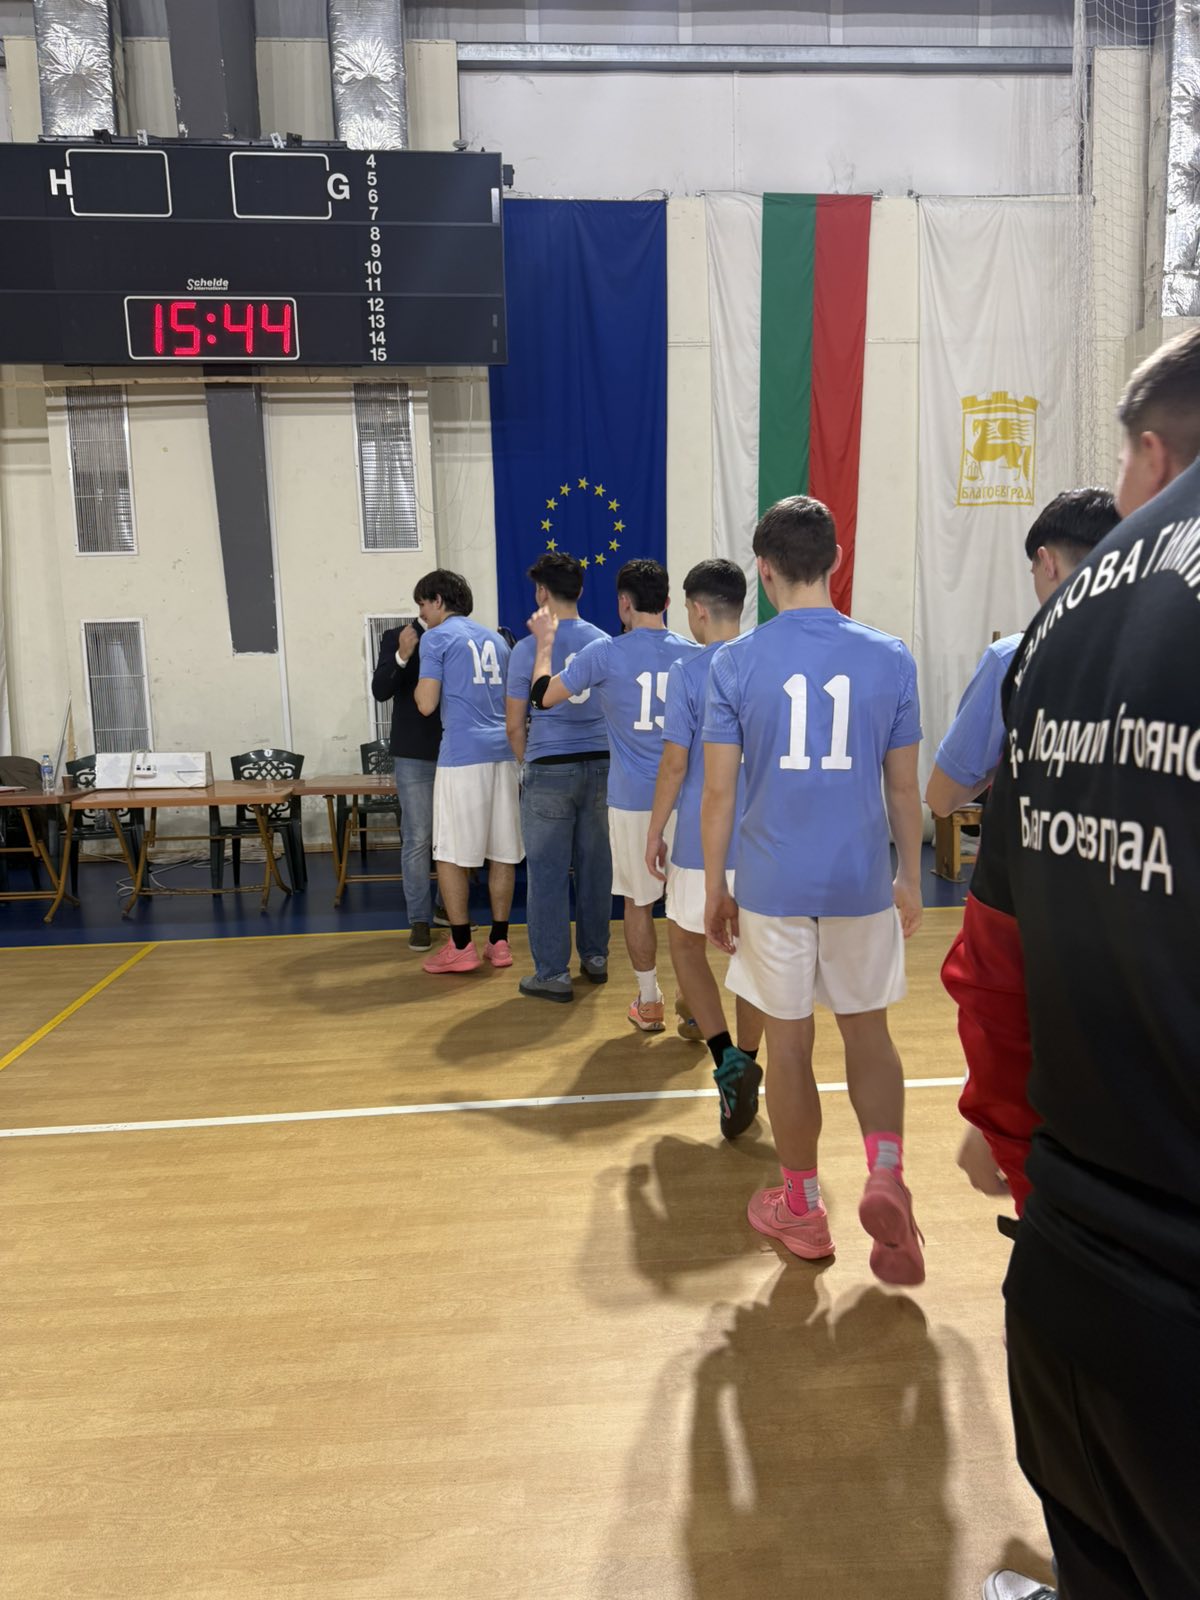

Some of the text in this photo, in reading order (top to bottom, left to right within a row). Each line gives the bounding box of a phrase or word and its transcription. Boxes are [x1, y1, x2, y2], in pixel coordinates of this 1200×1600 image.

[366, 153, 377, 168] 4
[49, 169, 73, 196] H
[327, 172, 350, 200] G
[367, 171, 378, 186] 5
[368, 188, 379, 204] 6
[369, 206, 379, 221] 7
[370, 226, 381, 241] 8
[371, 243, 382, 258] 9
[364, 260, 382, 275] 10
[186, 277, 229, 291] Schelde
[365, 277, 382, 292] 11
[367, 297, 385, 312] 12
[154, 301, 292, 356] 15:44
[368, 314, 386, 329] 13
[369, 331, 387, 345] 14
[369, 347, 388, 362] 15
[961, 485, 1033, 500] БЛАГОЕВГРАД
[467, 638, 503, 685] 14
[779, 673, 853, 770] 11
